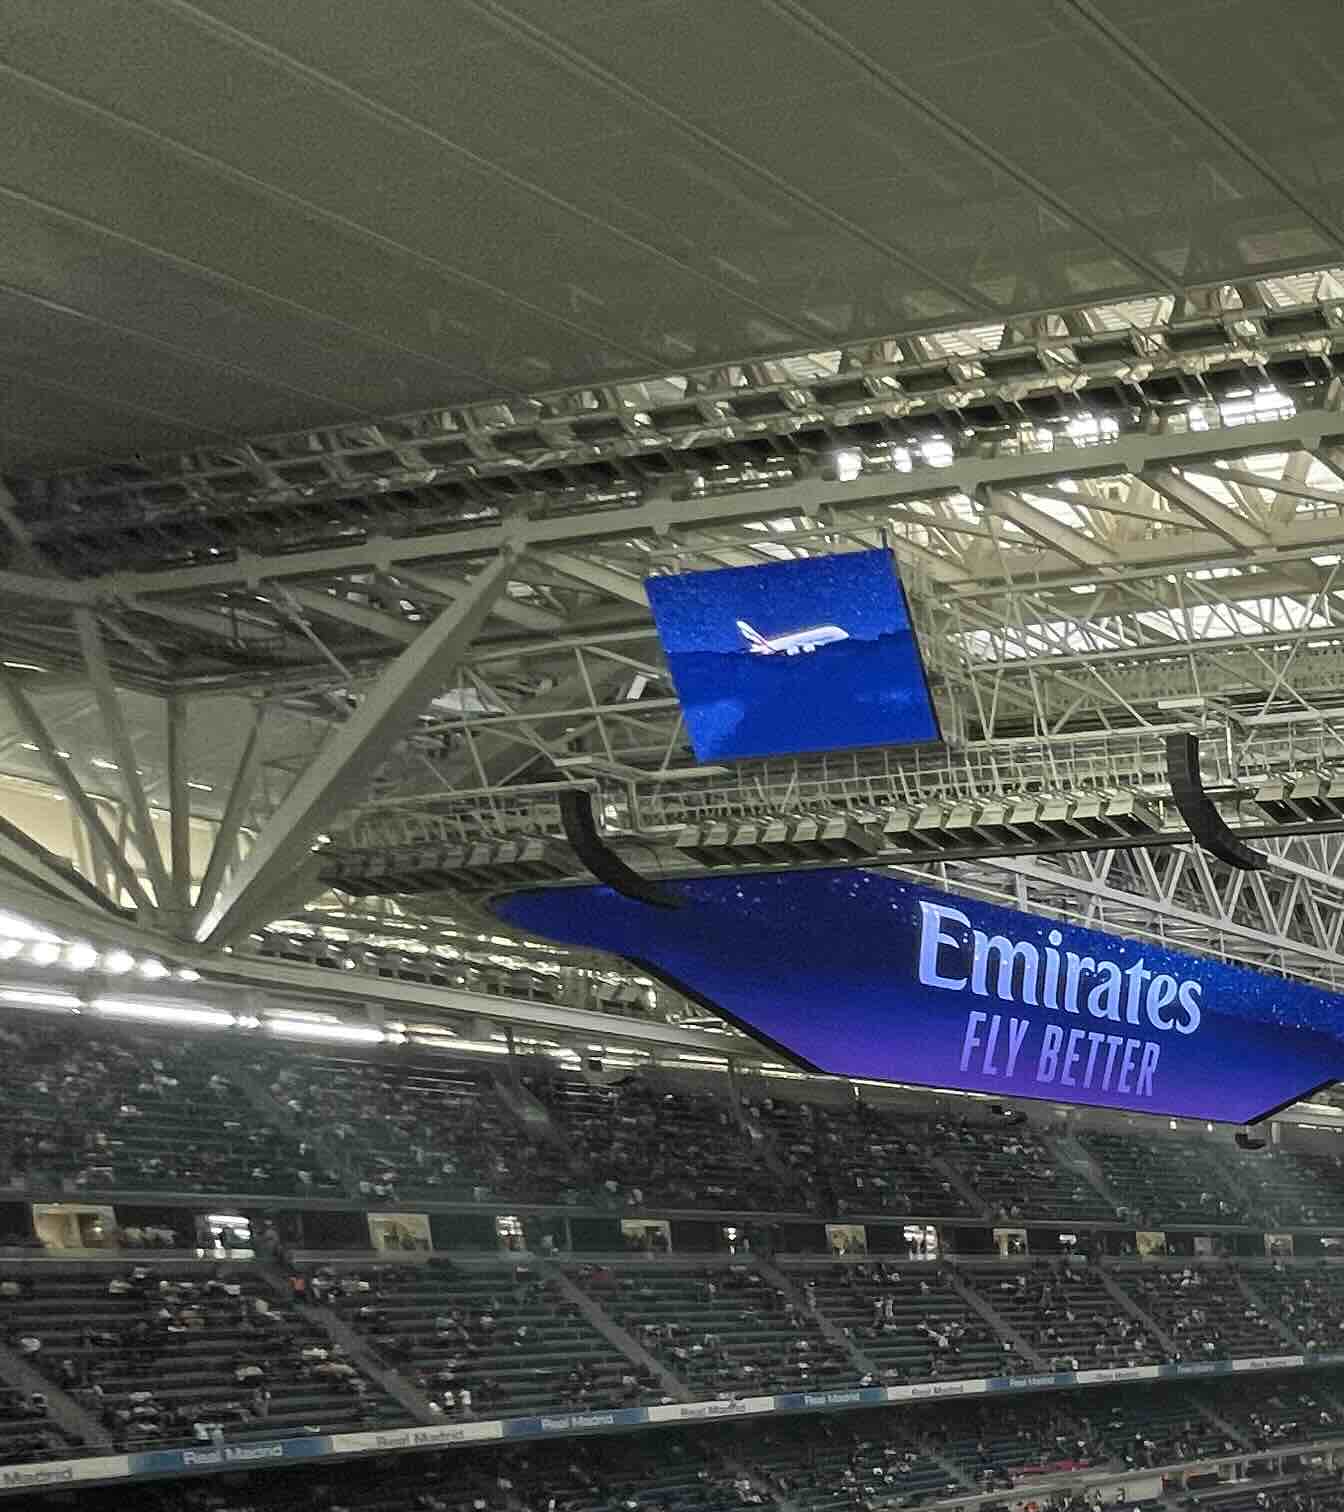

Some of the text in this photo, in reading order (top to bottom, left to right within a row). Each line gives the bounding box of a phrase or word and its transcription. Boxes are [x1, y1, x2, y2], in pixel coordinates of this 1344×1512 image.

[918, 900, 1202, 1034] Emirates
[960, 1010, 1161, 1097] FLY BETTER
